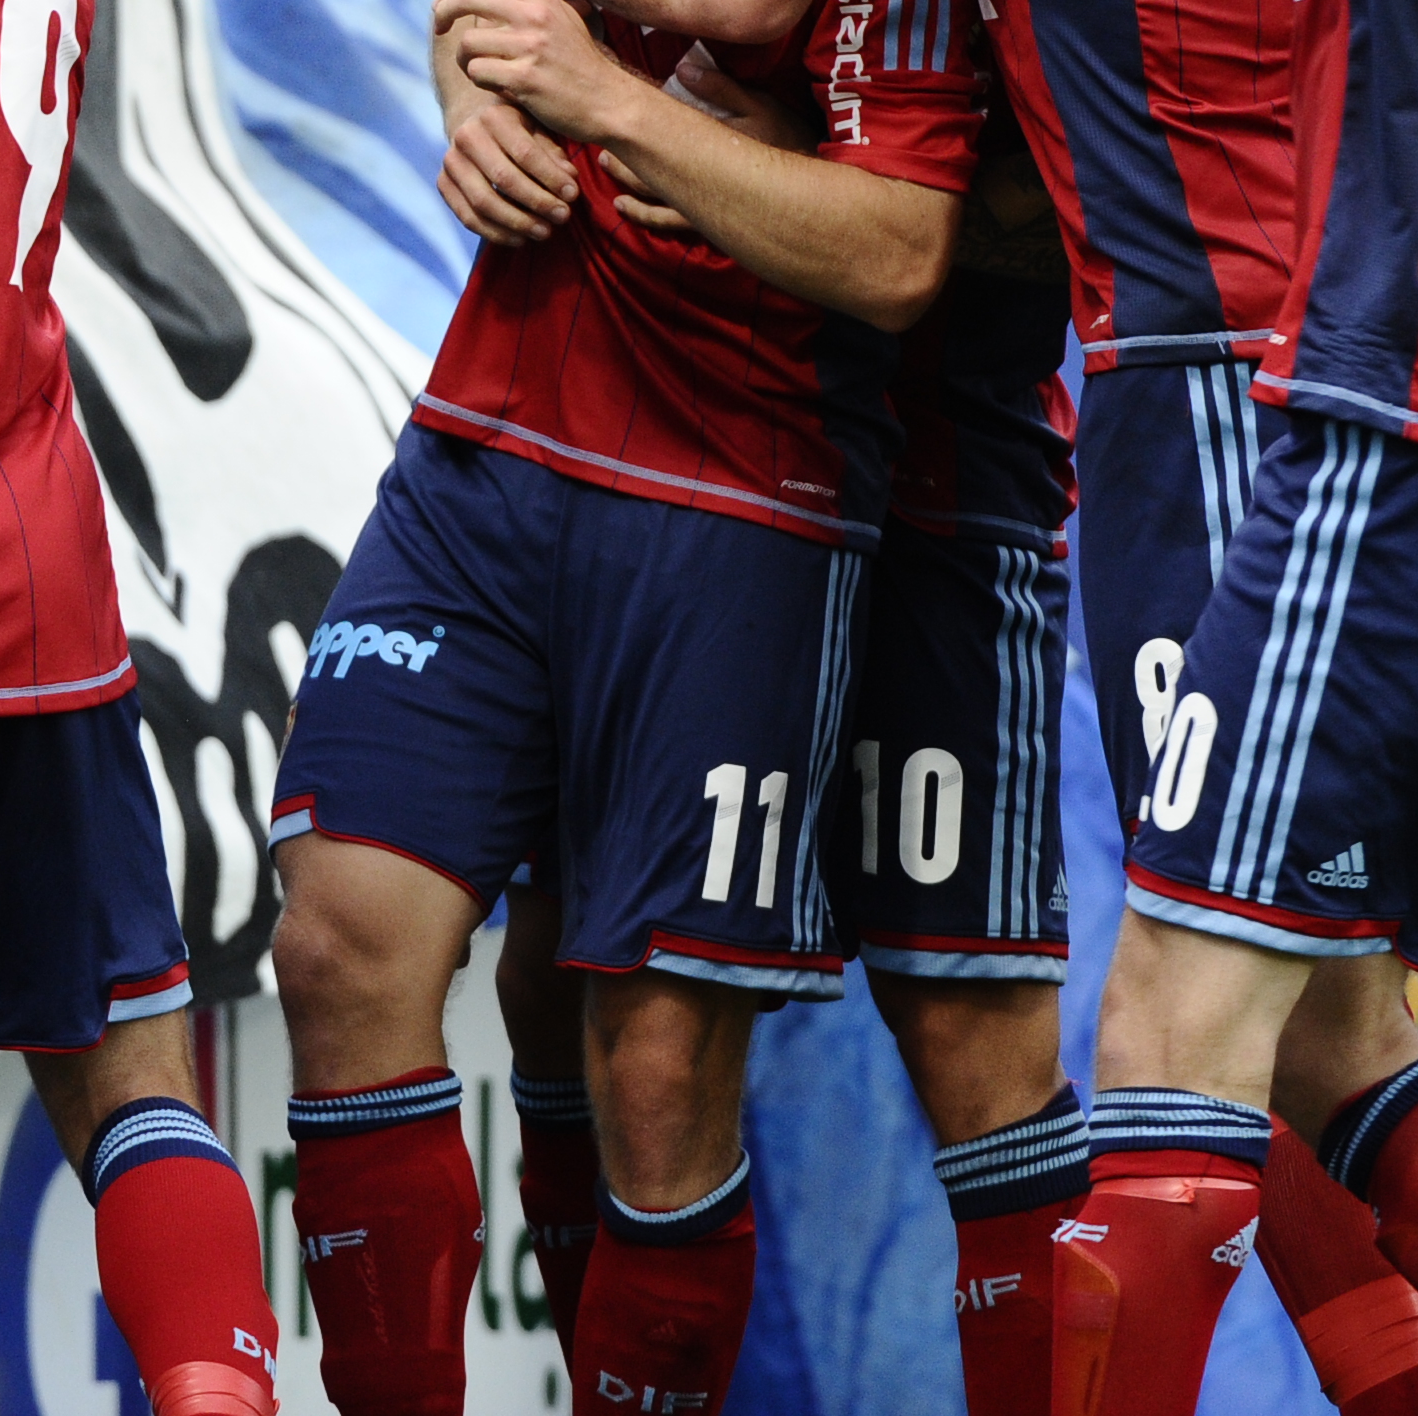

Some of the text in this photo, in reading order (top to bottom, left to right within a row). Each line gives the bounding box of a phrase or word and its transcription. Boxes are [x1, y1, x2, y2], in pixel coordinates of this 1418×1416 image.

[702, 763, 789, 909] 11
[852, 739, 964, 884] 10
[1306, 867, 1370, 889] adidas
[596, 1369, 709, 1415] DIF
